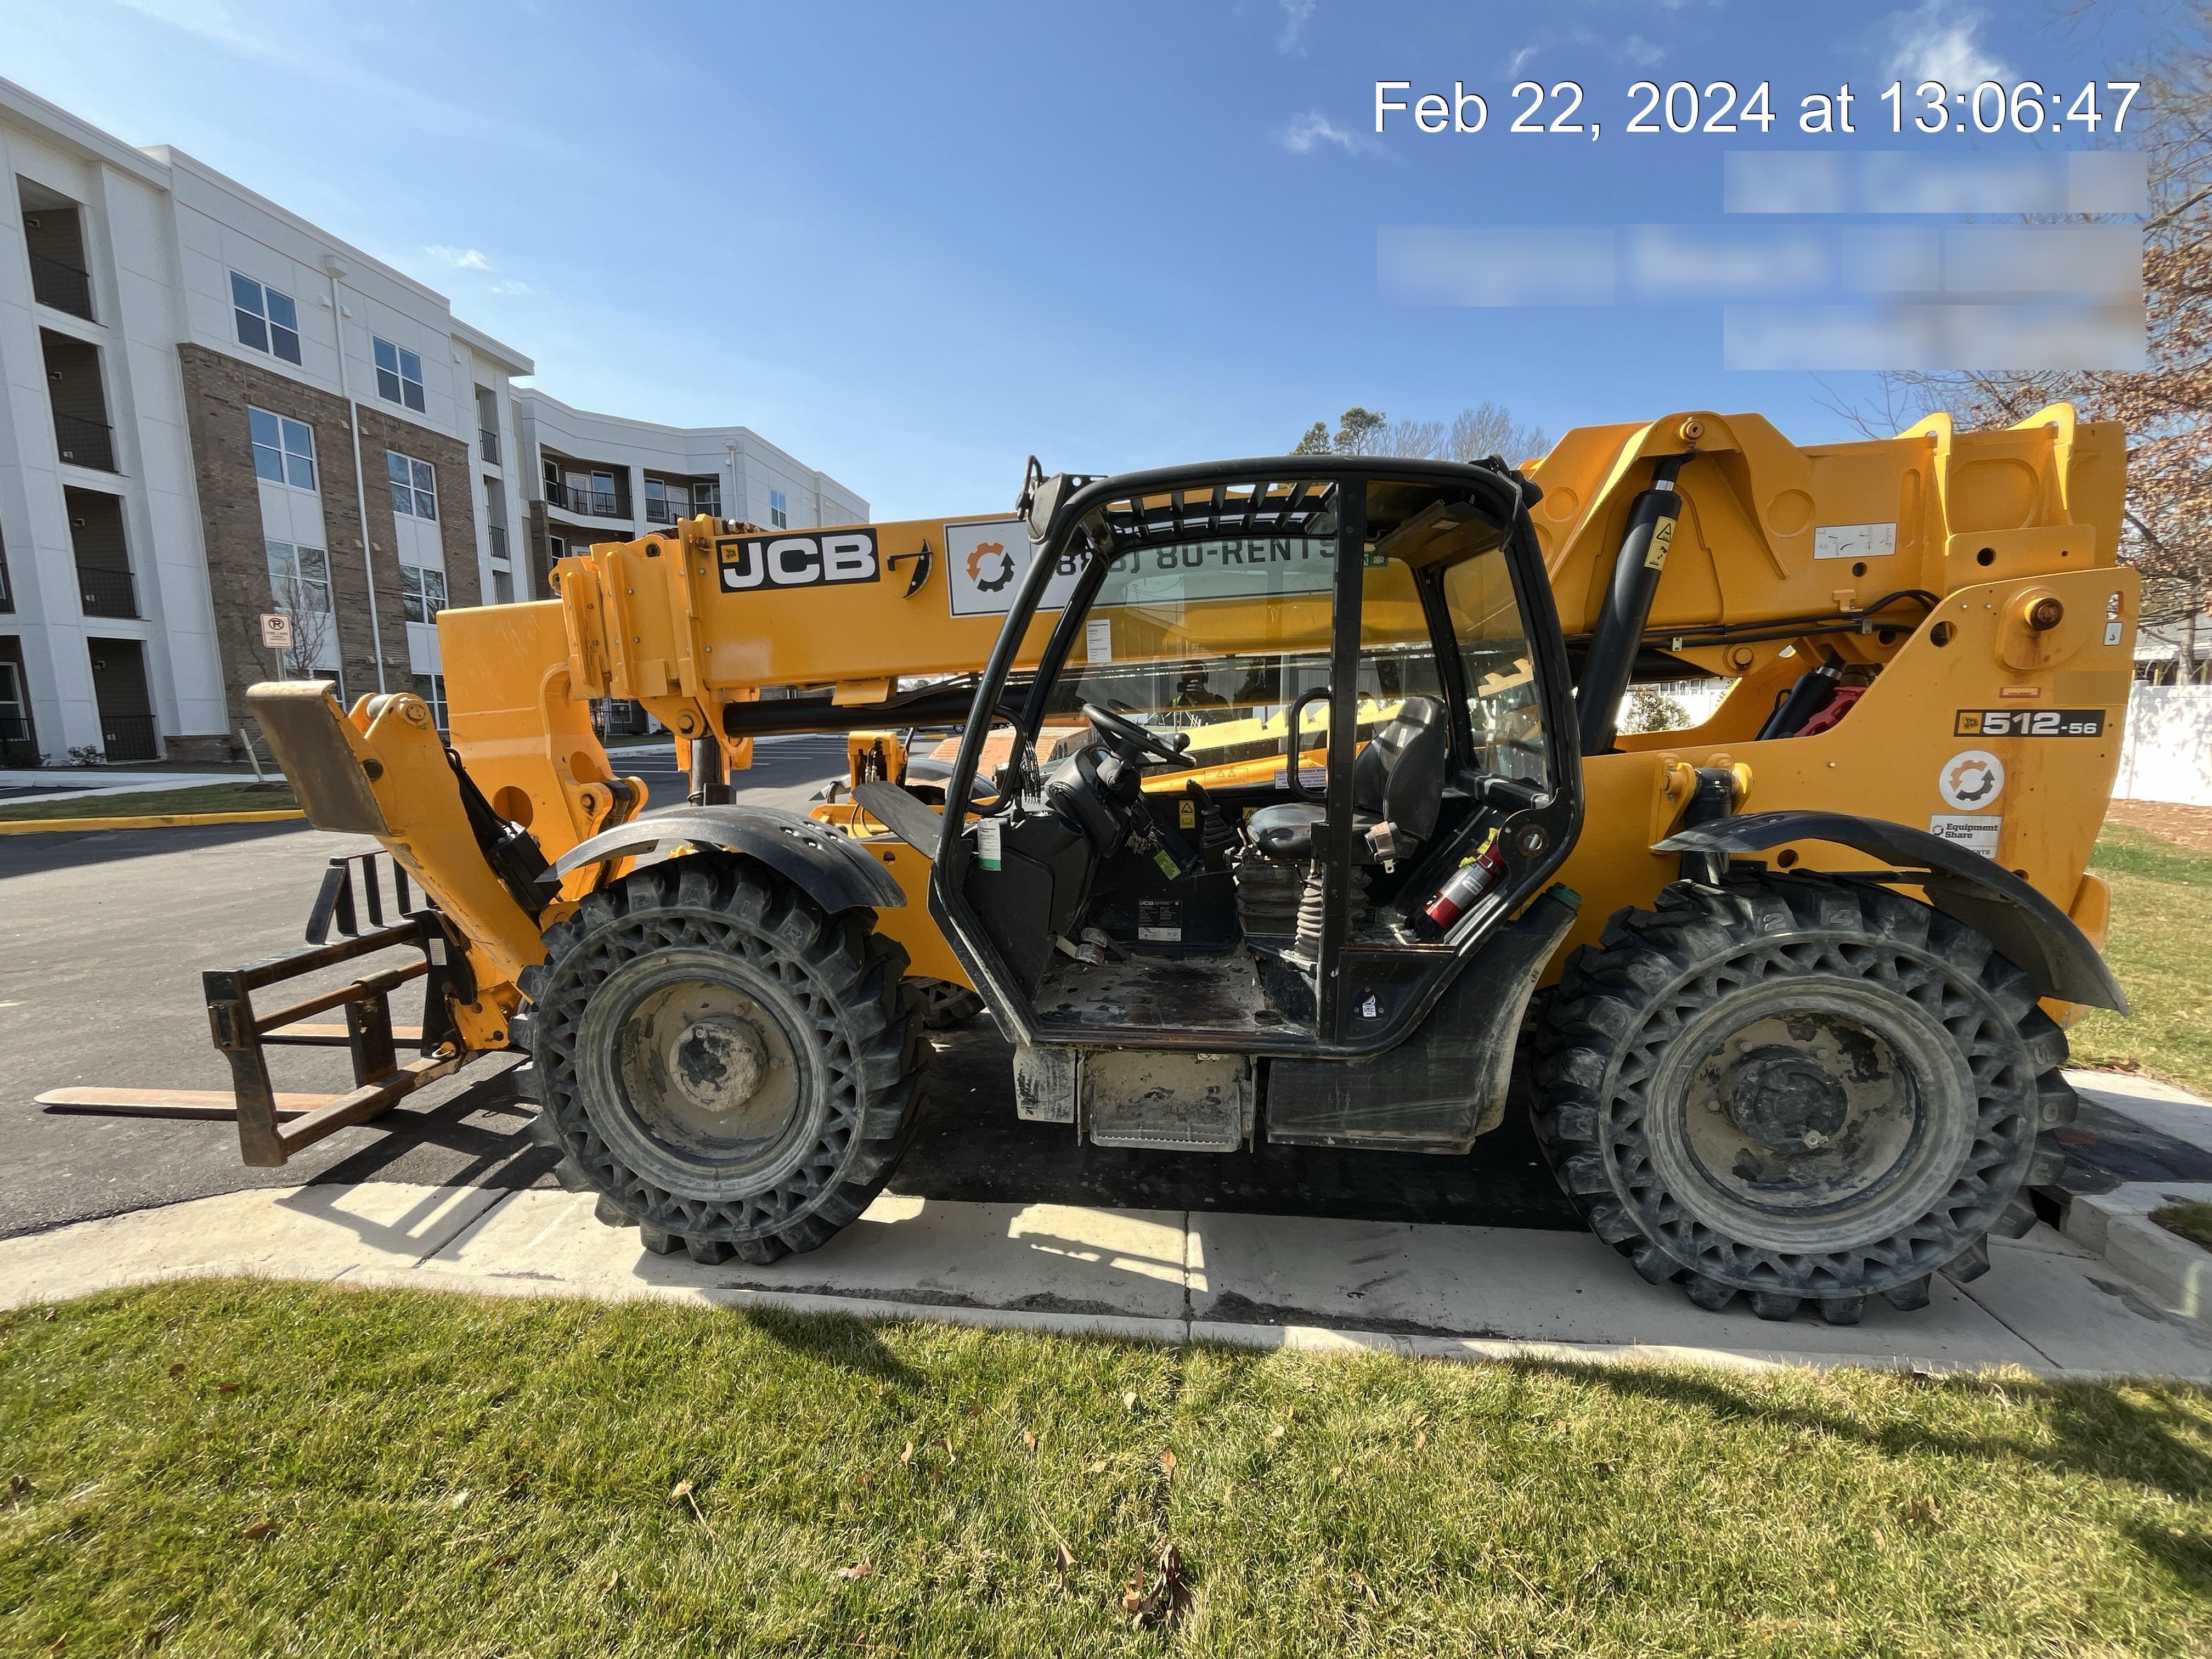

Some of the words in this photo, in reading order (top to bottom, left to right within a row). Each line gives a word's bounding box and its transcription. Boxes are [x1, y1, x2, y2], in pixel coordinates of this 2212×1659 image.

[724, 534, 876, 588] JCB
[1983, 712, 2097, 735] 512-56
[1946, 823, 1999, 832] Equipment
